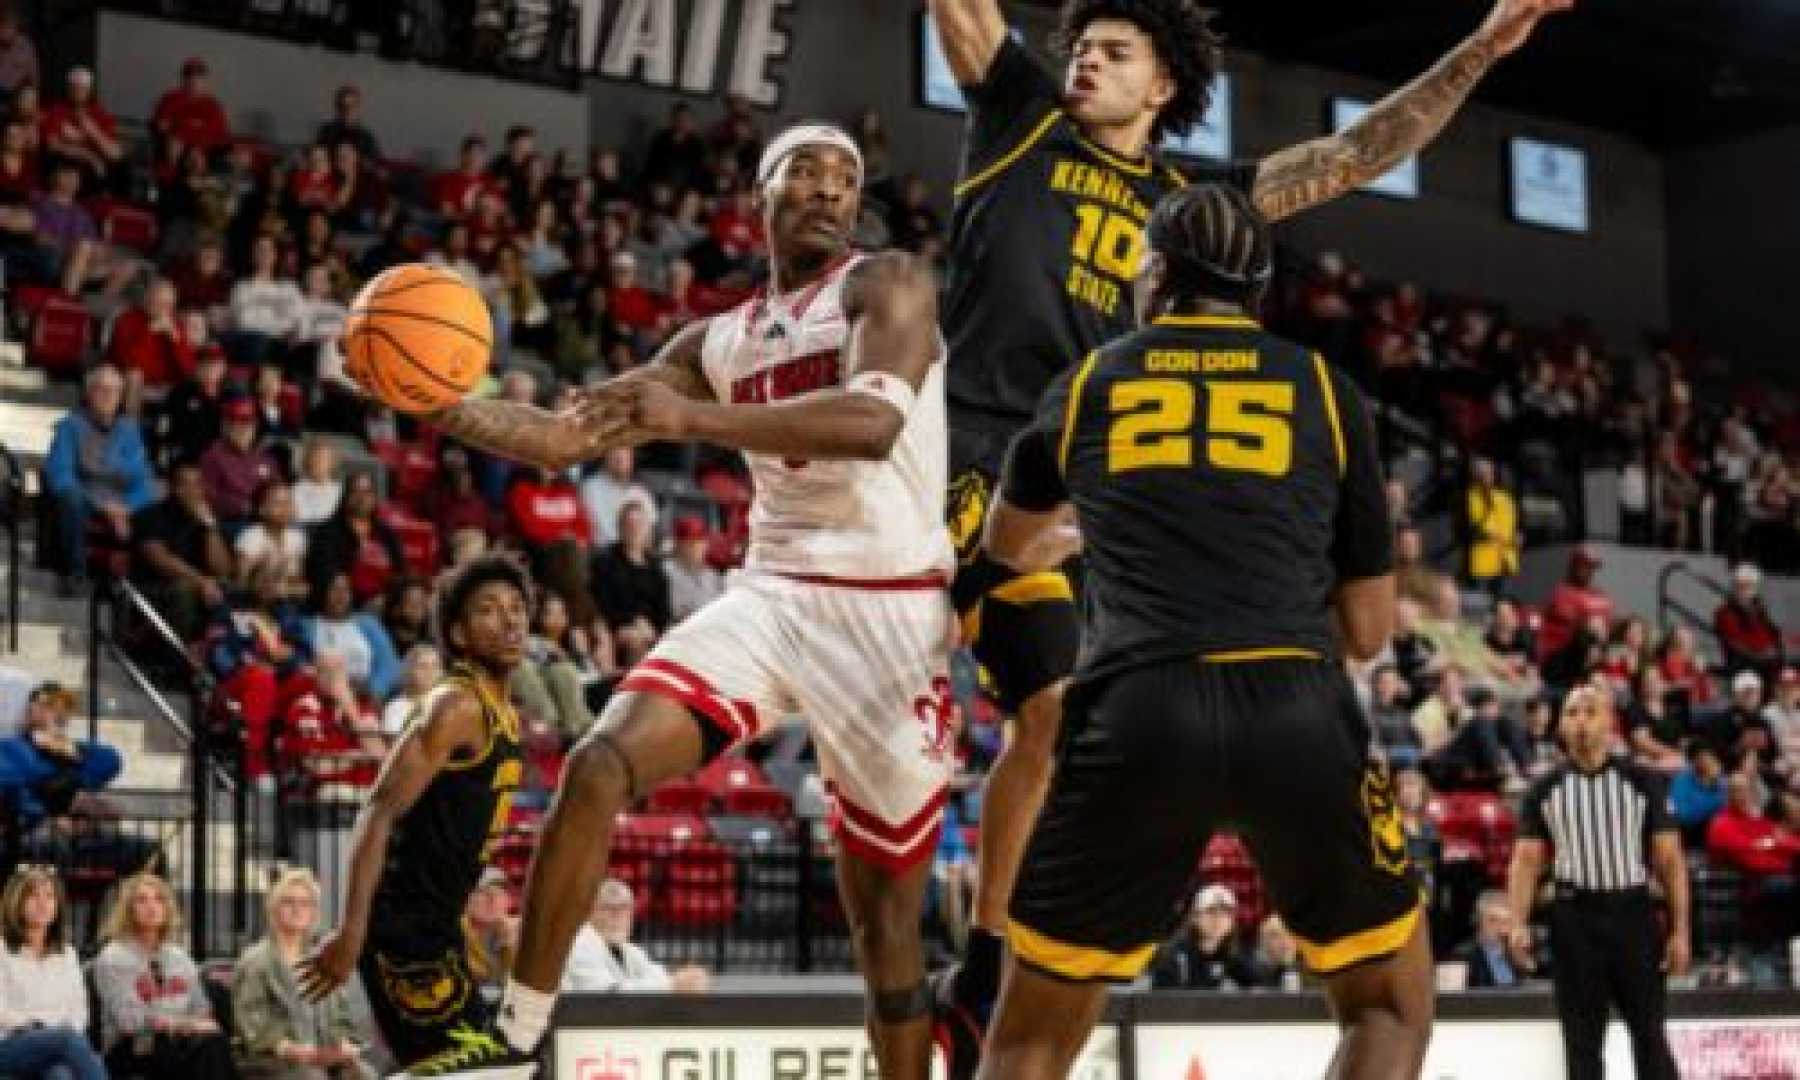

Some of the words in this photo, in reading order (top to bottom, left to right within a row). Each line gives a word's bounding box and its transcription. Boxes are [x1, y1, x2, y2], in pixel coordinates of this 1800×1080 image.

[1072, 205, 1147, 282] 10
[1146, 350, 1259, 372] GORDON
[1109, 379, 1294, 475] 25
